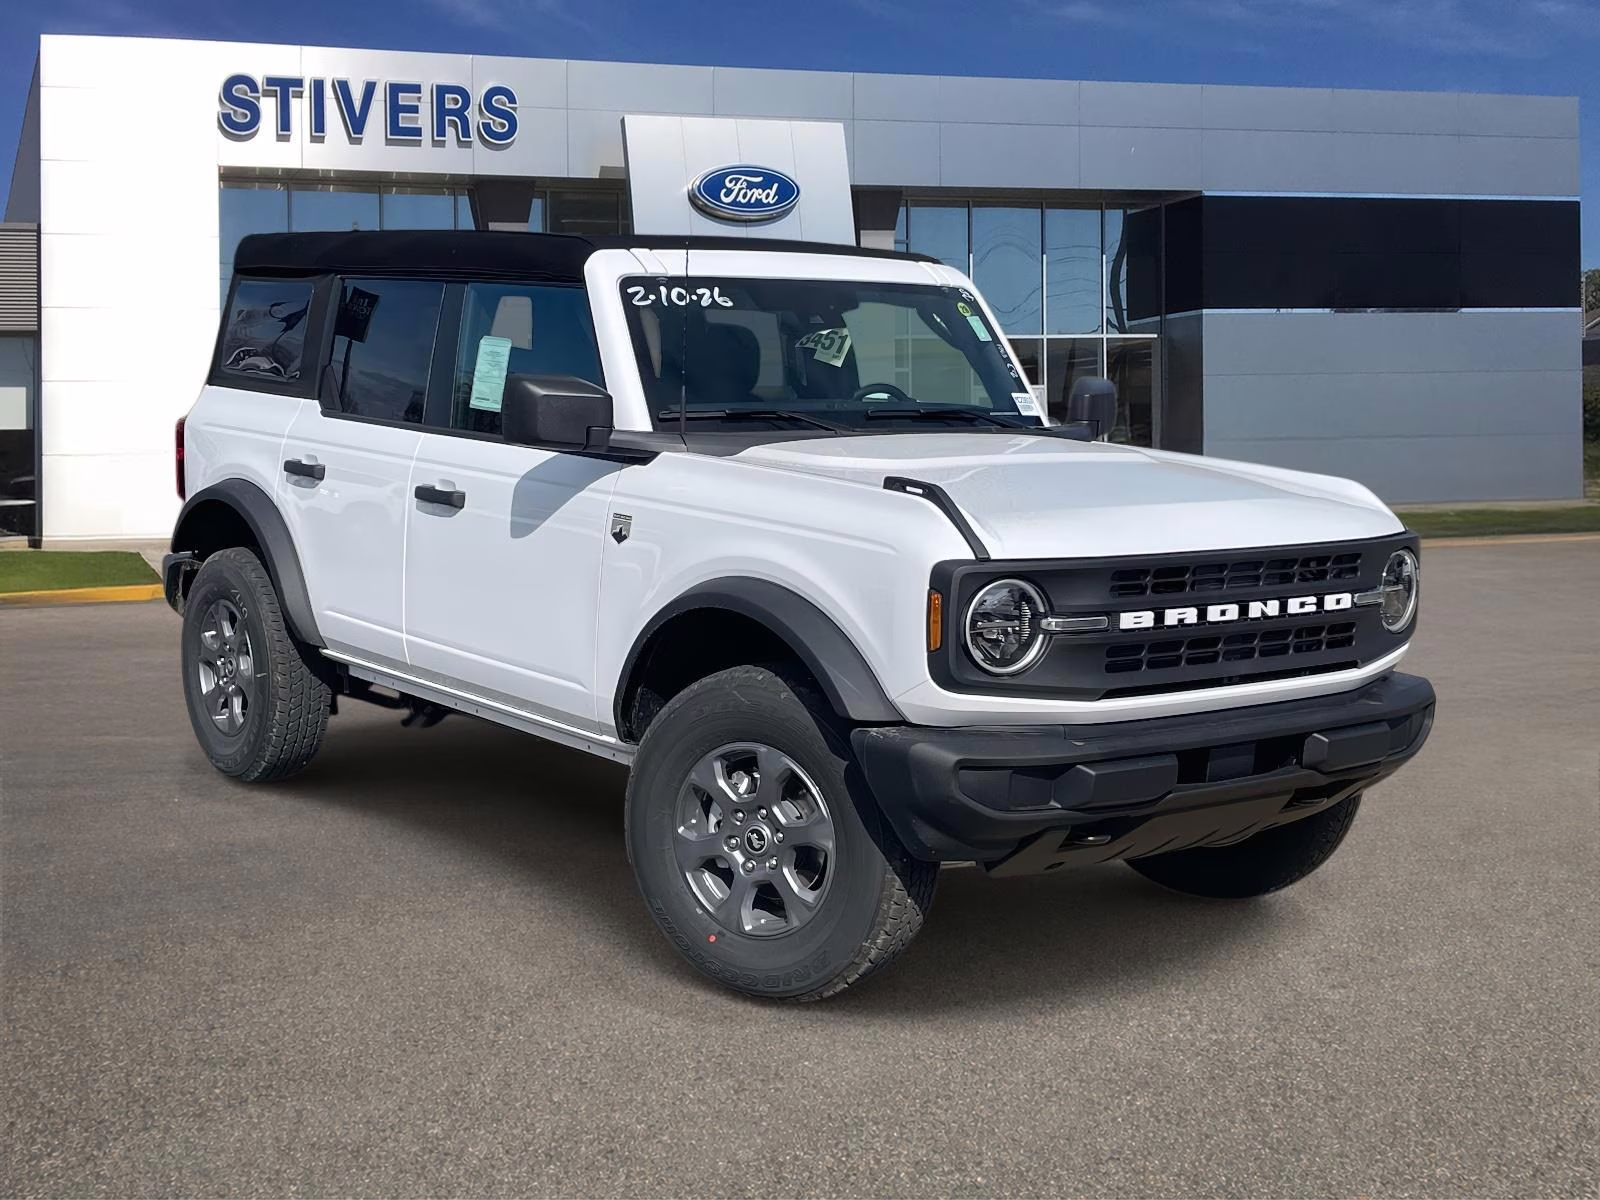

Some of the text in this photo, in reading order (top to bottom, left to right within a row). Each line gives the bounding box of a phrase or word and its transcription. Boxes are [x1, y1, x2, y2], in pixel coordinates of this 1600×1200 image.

[218, 72, 518, 146] STIVERS
[720, 174, 779, 204] Ford
[1119, 592, 1352, 630] BRONCO
